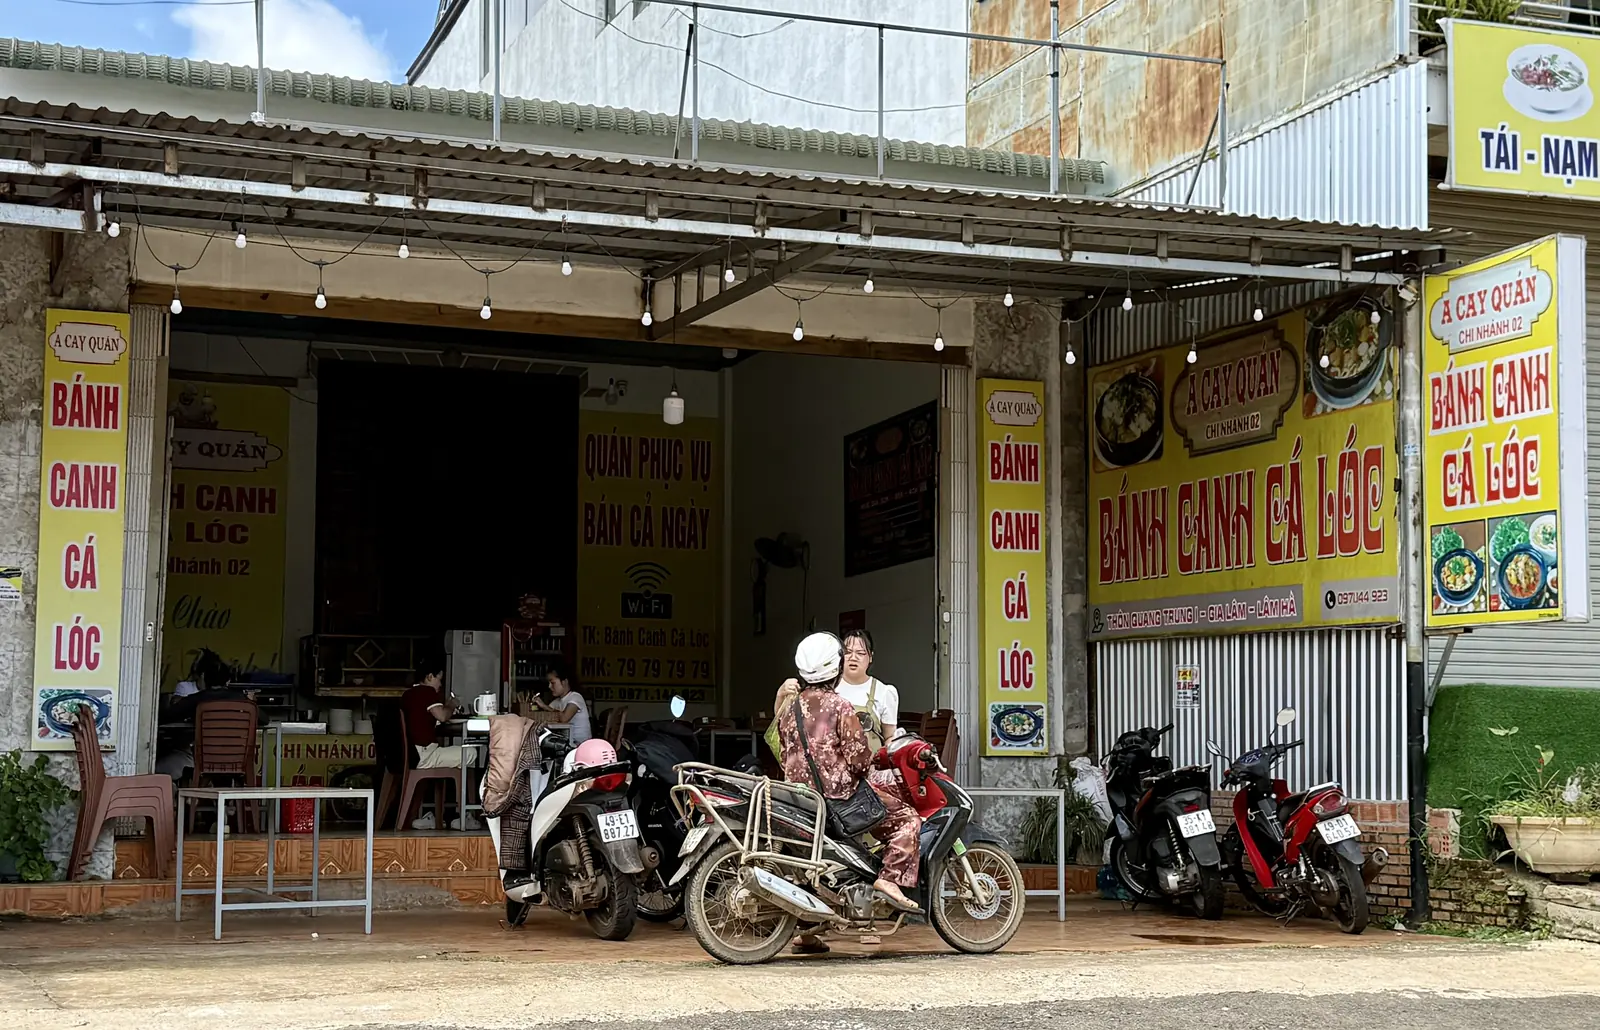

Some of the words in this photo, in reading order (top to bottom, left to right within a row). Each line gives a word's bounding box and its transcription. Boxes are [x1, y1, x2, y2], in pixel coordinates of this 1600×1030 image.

[1481, 125, 1518, 171] TÁI
[1527, 152, 1535, 161] -
[1543, 137, 1599, 184] NẠM
[1441, 299, 1452, 325] A
[1456, 288, 1488, 321] CAY
[1491, 271, 1537, 312] QUÁN
[54, 334, 62, 347] A
[65, 334, 86, 352] CAY
[88, 336, 120, 353] QUÁN
[1458, 329, 1474, 344] CHI
[1476, 319, 1509, 340] NHÁNH
[1512, 316, 1523, 332] 02
[1186, 373, 1198, 416] A
[1201, 362, 1232, 413] CAY
[1236, 338, 1281, 406] QUÁN
[1431, 360, 1485, 430] BÁNH
[1493, 352, 1550, 418] CANH
[52, 374, 119, 429] BÁNH
[990, 400, 996, 412] A
[997, 401, 1013, 415] CAY
[1206, 422, 1219, 440] CHI
[1221, 415, 1249, 436] NHÁNH
[1250, 413, 1260, 430] 02
[198, 440, 267, 460] QUÁN
[585, 426, 632, 482] QUÁN
[639, 436, 684, 490] PHỤC
[690, 439, 711, 491] VỤ
[990, 435, 1039, 482] BÁNH
[1443, 436, 1476, 507] CÁ
[1486, 428, 1539, 501] LÓC
[50, 462, 117, 510] CANH
[196, 484, 276, 514] CANH
[1099, 471, 1169, 585] BÁNH
[1177, 469, 1255, 575] CANH
[1265, 435, 1308, 565] CÁ
[1316, 424, 1383, 559] LÓC
[186, 519, 249, 544] LÓC
[584, 494, 622, 546] BÁN
[630, 491, 654, 547] CẢ
[661, 498, 710, 550] NGÀY
[991, 511, 1039, 550] CANH
[64, 535, 97, 590] CÁ
[228, 558, 250, 576] 02
[172, 594, 231, 629] Chào
[1004, 573, 1028, 619] CÁ
[1107, 608, 1130, 630] THÔN
[1131, 610, 1161, 629] QUANG
[1163, 606, 1193, 625] TRUNG
[1208, 604, 1224, 622] GIA
[1226, 598, 1247, 621] LÂM
[1257, 595, 1279, 618] LÂM
[1281, 590, 1297, 617] HÀ
[1372, 589, 1388, 602] 923
[54, 616, 100, 671] LÓC
[582, 625, 600, 645] TK:
[604, 625, 633, 646] Bánh
[638, 627, 666, 647] Canh
[671, 627, 685, 647] Cá
[581, 657, 611, 678] MK:
[617, 658, 636, 678] 79
[641, 658, 661, 678] 79
[667, 659, 686, 679] 79
[692, 660, 710, 679] 79
[1000, 642, 1033, 688] LÓC
[306, 739, 363, 759] NHÁNH
[605, 813, 630, 827] 49-E1
